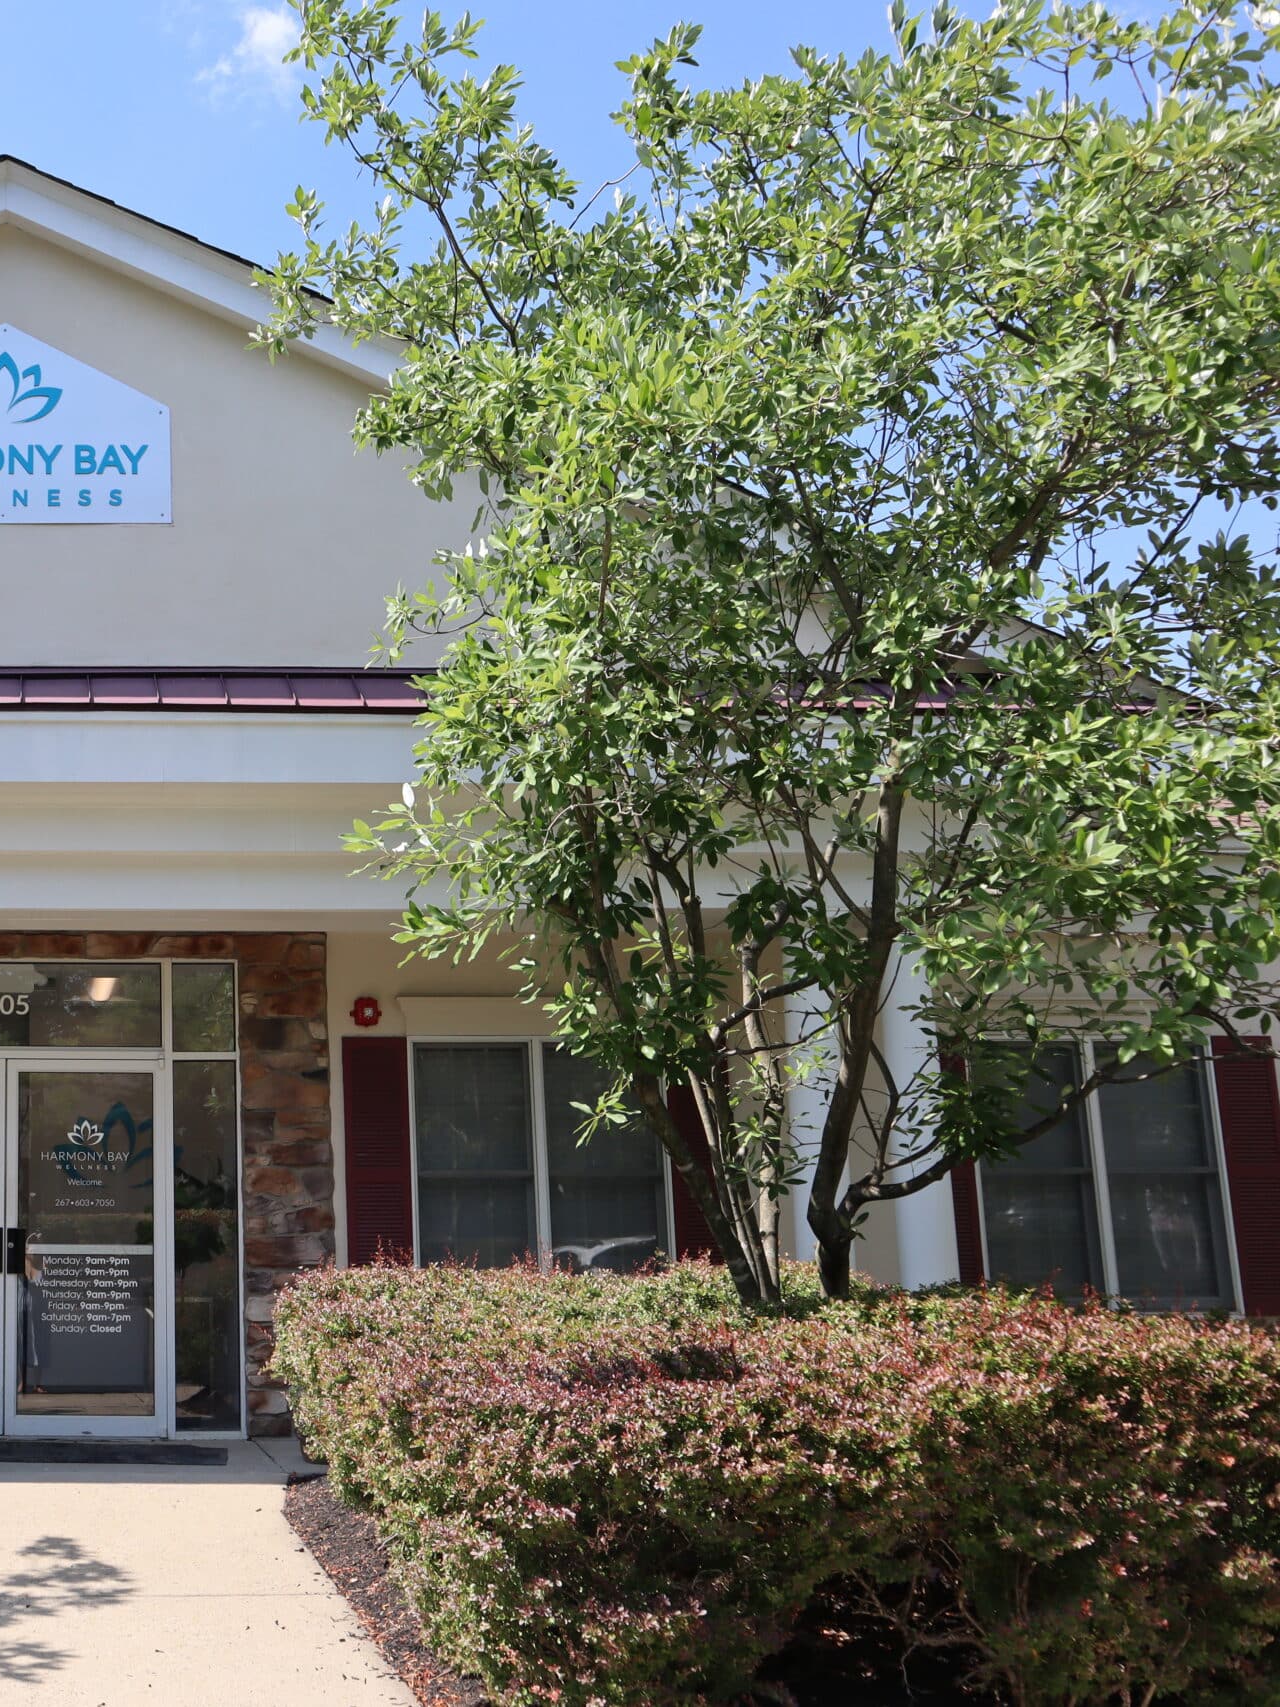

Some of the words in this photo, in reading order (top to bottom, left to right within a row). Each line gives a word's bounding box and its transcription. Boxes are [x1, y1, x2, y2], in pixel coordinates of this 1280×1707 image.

[74, 444, 149, 475] BAY
[40, 1151, 104, 1161] HARMONY
[107, 1151, 130, 1162] BAY
[66, 1178, 103, 1186] Welcome
[42, 1255, 83, 1266] Monday:
[85, 1256, 130, 1266] 9am-9pm
[43, 1267, 82, 1277] Tuesday:
[84, 1267, 129, 1277] 9am-9pm
[34, 1279, 91, 1288] Wednesday:
[93, 1279, 138, 1289] 9am-9pm
[42, 1289, 84, 1299] Thursday:
[86, 1290, 131, 1300] 9am-9pm
[47, 1301, 78, 1311] Friday:
[79, 1301, 125, 1311] 9am-9pm
[41, 1312, 85, 1322] Saturday:
[86, 1313, 131, 1322] 9am-7pm
[50, 1323, 87, 1333] Sunday:
[89, 1324, 122, 1333] Closed
